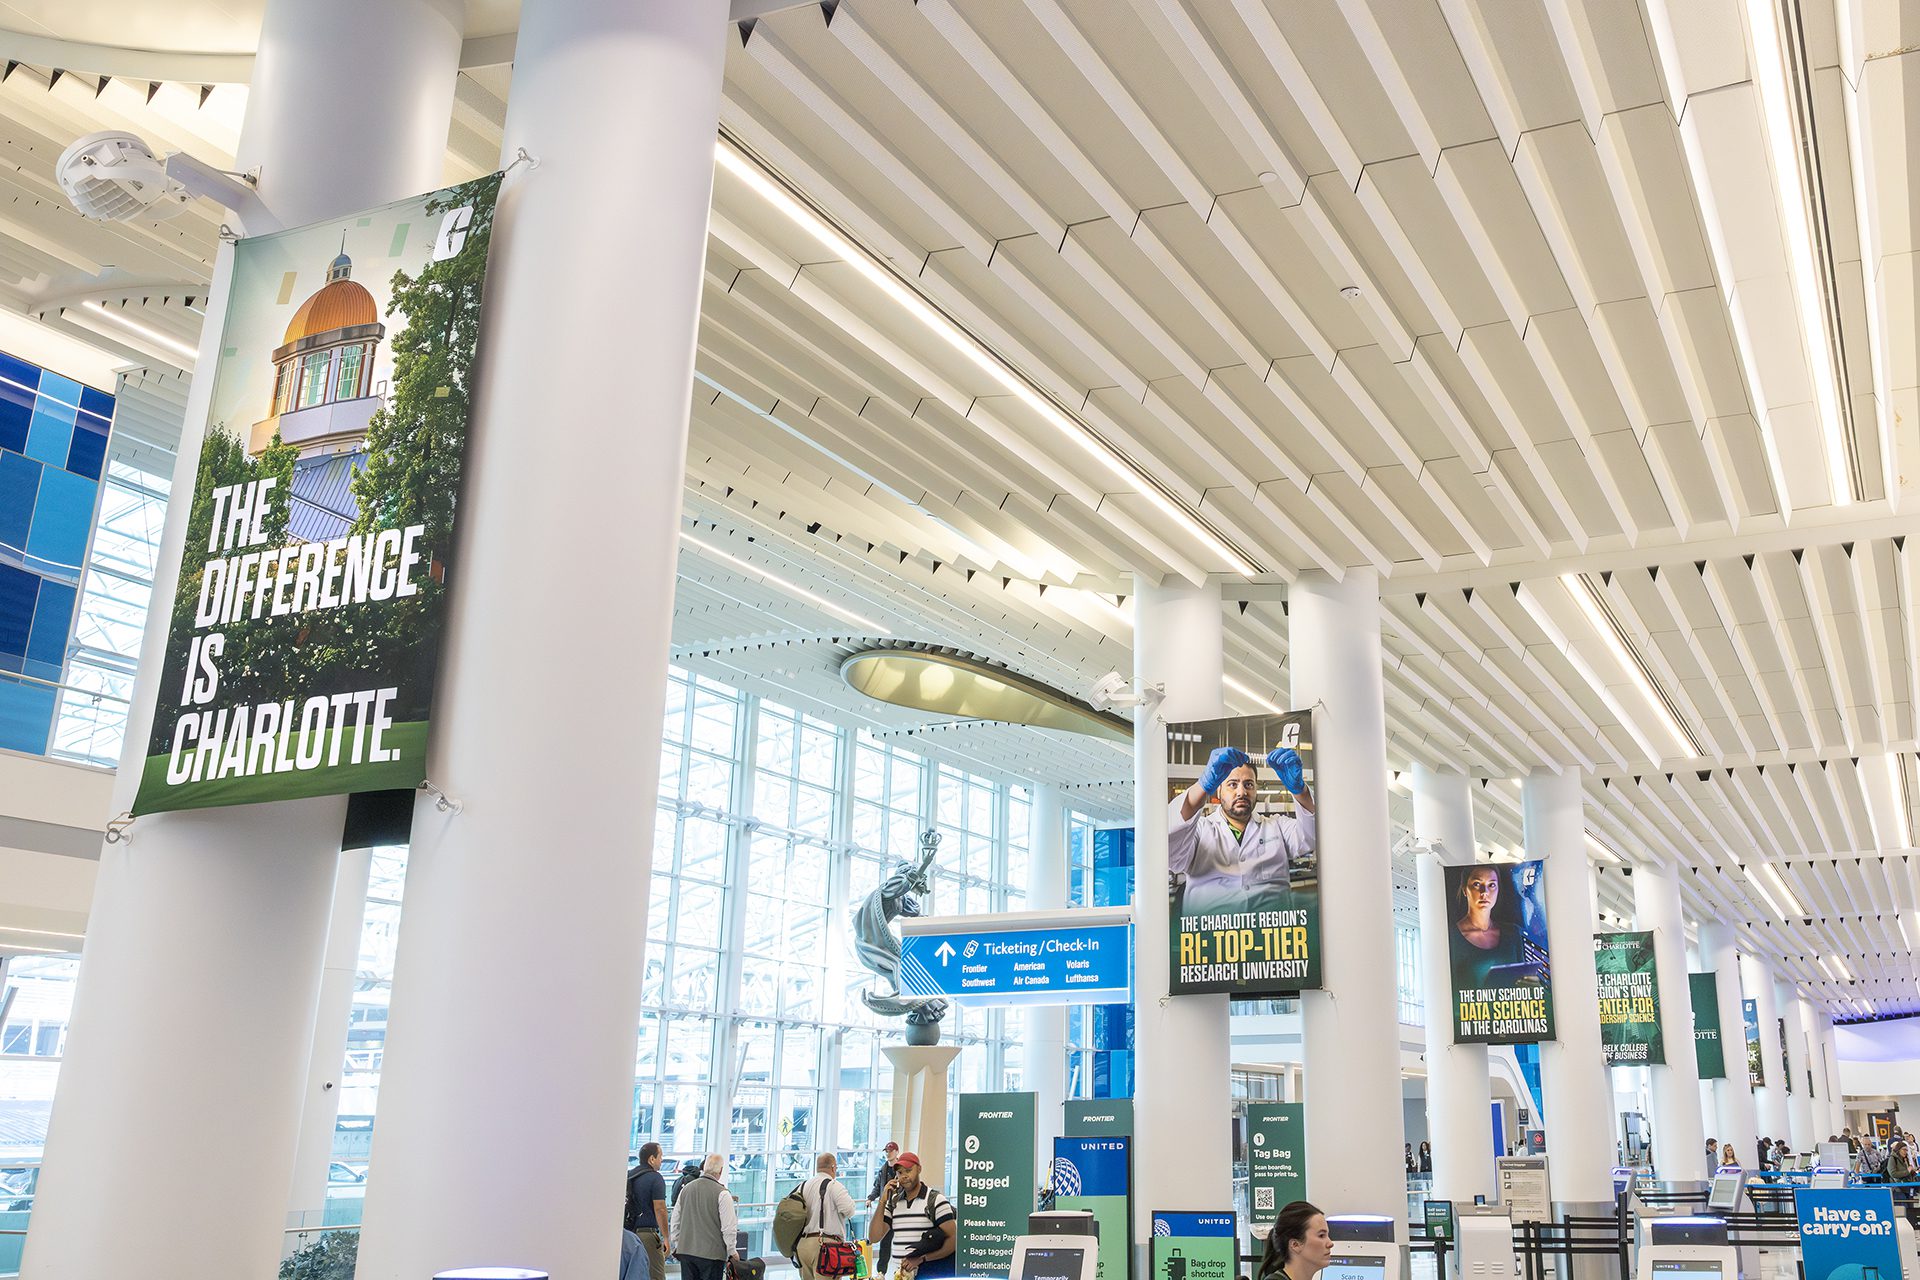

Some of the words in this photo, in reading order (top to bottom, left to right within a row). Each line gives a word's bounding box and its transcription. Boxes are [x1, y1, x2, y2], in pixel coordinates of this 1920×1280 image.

[207, 477, 278, 552] THE
[194, 524, 425, 628] DIFFERENCE
[180, 632, 224, 706] IS
[165, 686, 401, 785] CHARLOTTE.
[1180, 916, 1198, 932] THE
[1201, 912, 1257, 931] CHARLOTTE
[1259, 910, 1307, 928] REGION'S
[1213, 927, 1308, 963] TOP-TIER
[962, 964, 987, 974] Frontier
[1013, 961, 1045, 971] American
[1066, 959, 1089, 969] Volaris
[1180, 962, 1238, 983] RESEARCH
[1242, 959, 1309, 980] UNIVERSITY
[962, 978, 995, 988] Southwest
[1013, 977, 1023, 986] Air
[1025, 976, 1049, 985] Canada
[1065, 974, 1099, 984] Lufthansa
[1604, 972, 1651, 986] CHARLOTTE
[1459, 990, 1475, 1003] THE
[1476, 988, 1496, 1002] ONLY
[1498, 987, 1532, 1001] SCHOOL
[1534, 987, 1544, 1000] OF
[1597, 985, 1629, 999] GION'S
[1630, 984, 1652, 998] ONLY
[1459, 1002, 1490, 1021] DATA
[1493, 1000, 1547, 1020] SCIENCE
[1598, 998, 1630, 1014] ENTER
[1632, 997, 1654, 1013] FOR
[1600, 1014, 1627, 1024] DERSHIP
[1629, 1013, 1655, 1023] SCIENCE
[1460, 1021, 1471, 1036] IN
[1473, 1020, 1491, 1035] THE
[1493, 1018, 1548, 1035] CAROLINAS
[1694, 1031, 1717, 1040] OTTE
[1603, 1044, 1619, 1052] BELK
[1620, 1043, 1648, 1051] COLLEGE
[1614, 1051, 1648, 1060] BUSINESS
[978, 1111, 1013, 1119] FRONTIER
[968, 1139, 976, 1149] 2
[1081, 1143, 1124, 1151] UNITED
[1253, 1149, 1270, 1159] Tag
[1272, 1149, 1291, 1159] Bag
[964, 1159, 994, 1172] Drop
[964, 1176, 1009, 1190] Tagged
[964, 1194, 987, 1208] Bag
[1813, 1207, 1860, 1222] Have
[1865, 1210, 1877, 1222] a
[964, 1219, 985, 1227] Please
[987, 1219, 1006, 1227] have:
[1802, 1220, 1892, 1238] carry-on?
[970, 1233, 1001, 1242] Boarding
[970, 1247, 986, 1256] Bags
[988, 1248, 1013, 1256] tagged
[970, 1262, 1010, 1270] Identificatio
[1190, 1259, 1207, 1268] Bag
[1207, 1259, 1226, 1268] drop
[1190, 1270, 1225, 1278] shortcut
